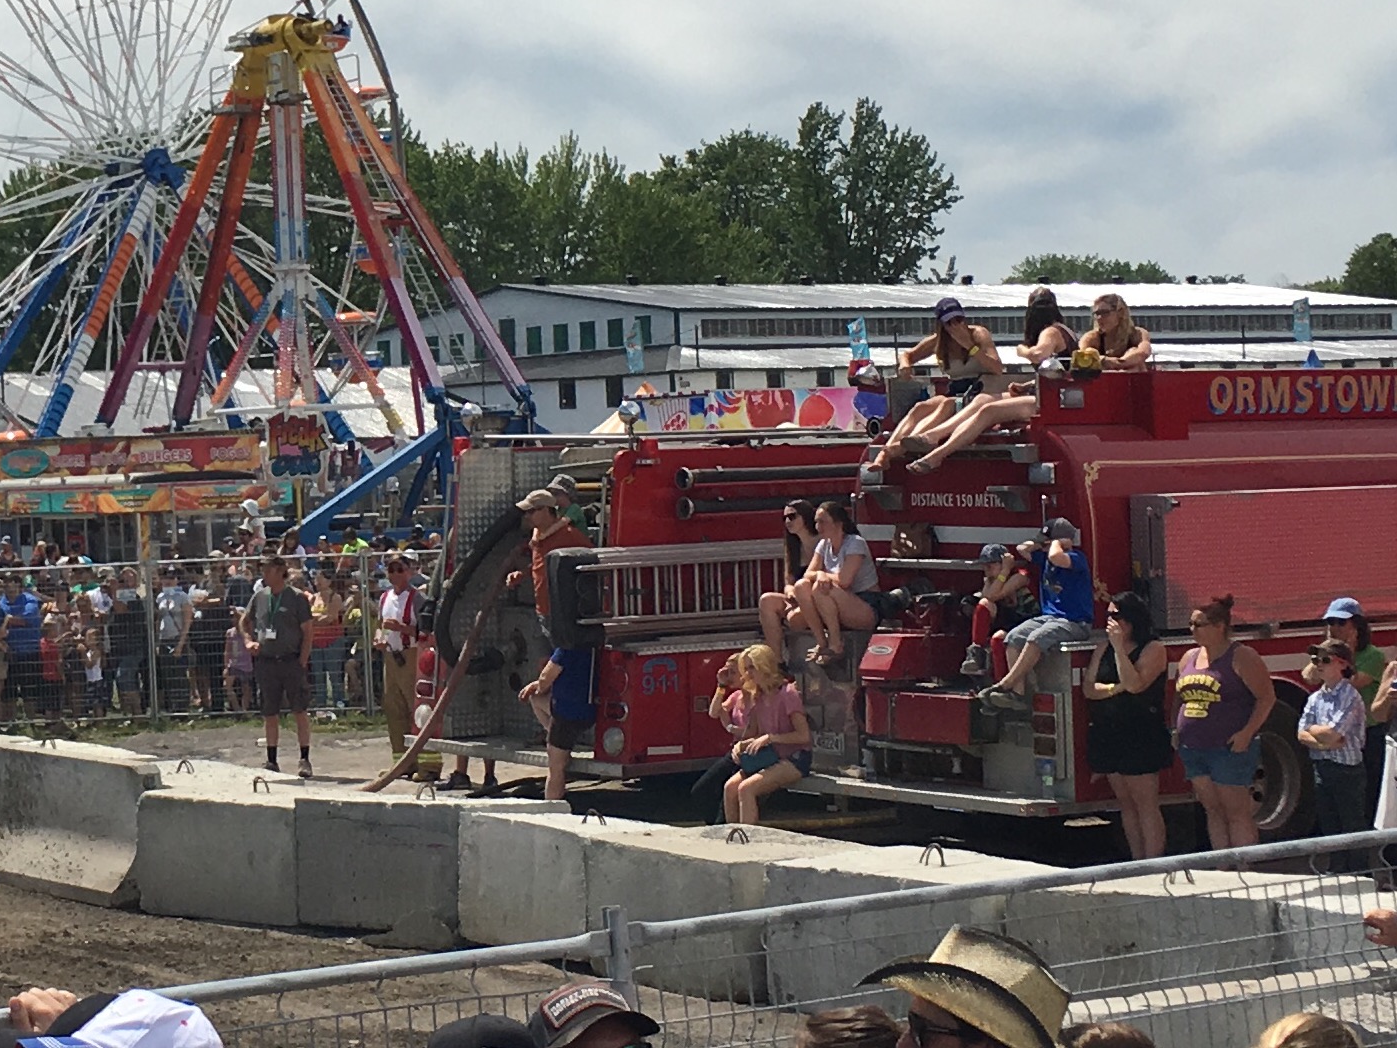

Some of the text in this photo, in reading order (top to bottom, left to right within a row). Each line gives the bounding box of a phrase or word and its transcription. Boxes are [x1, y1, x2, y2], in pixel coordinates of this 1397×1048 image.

[139, 448, 193, 464] BURGERS
[911, 493, 954, 507] DISTANCE
[956, 494, 973, 508] 150
